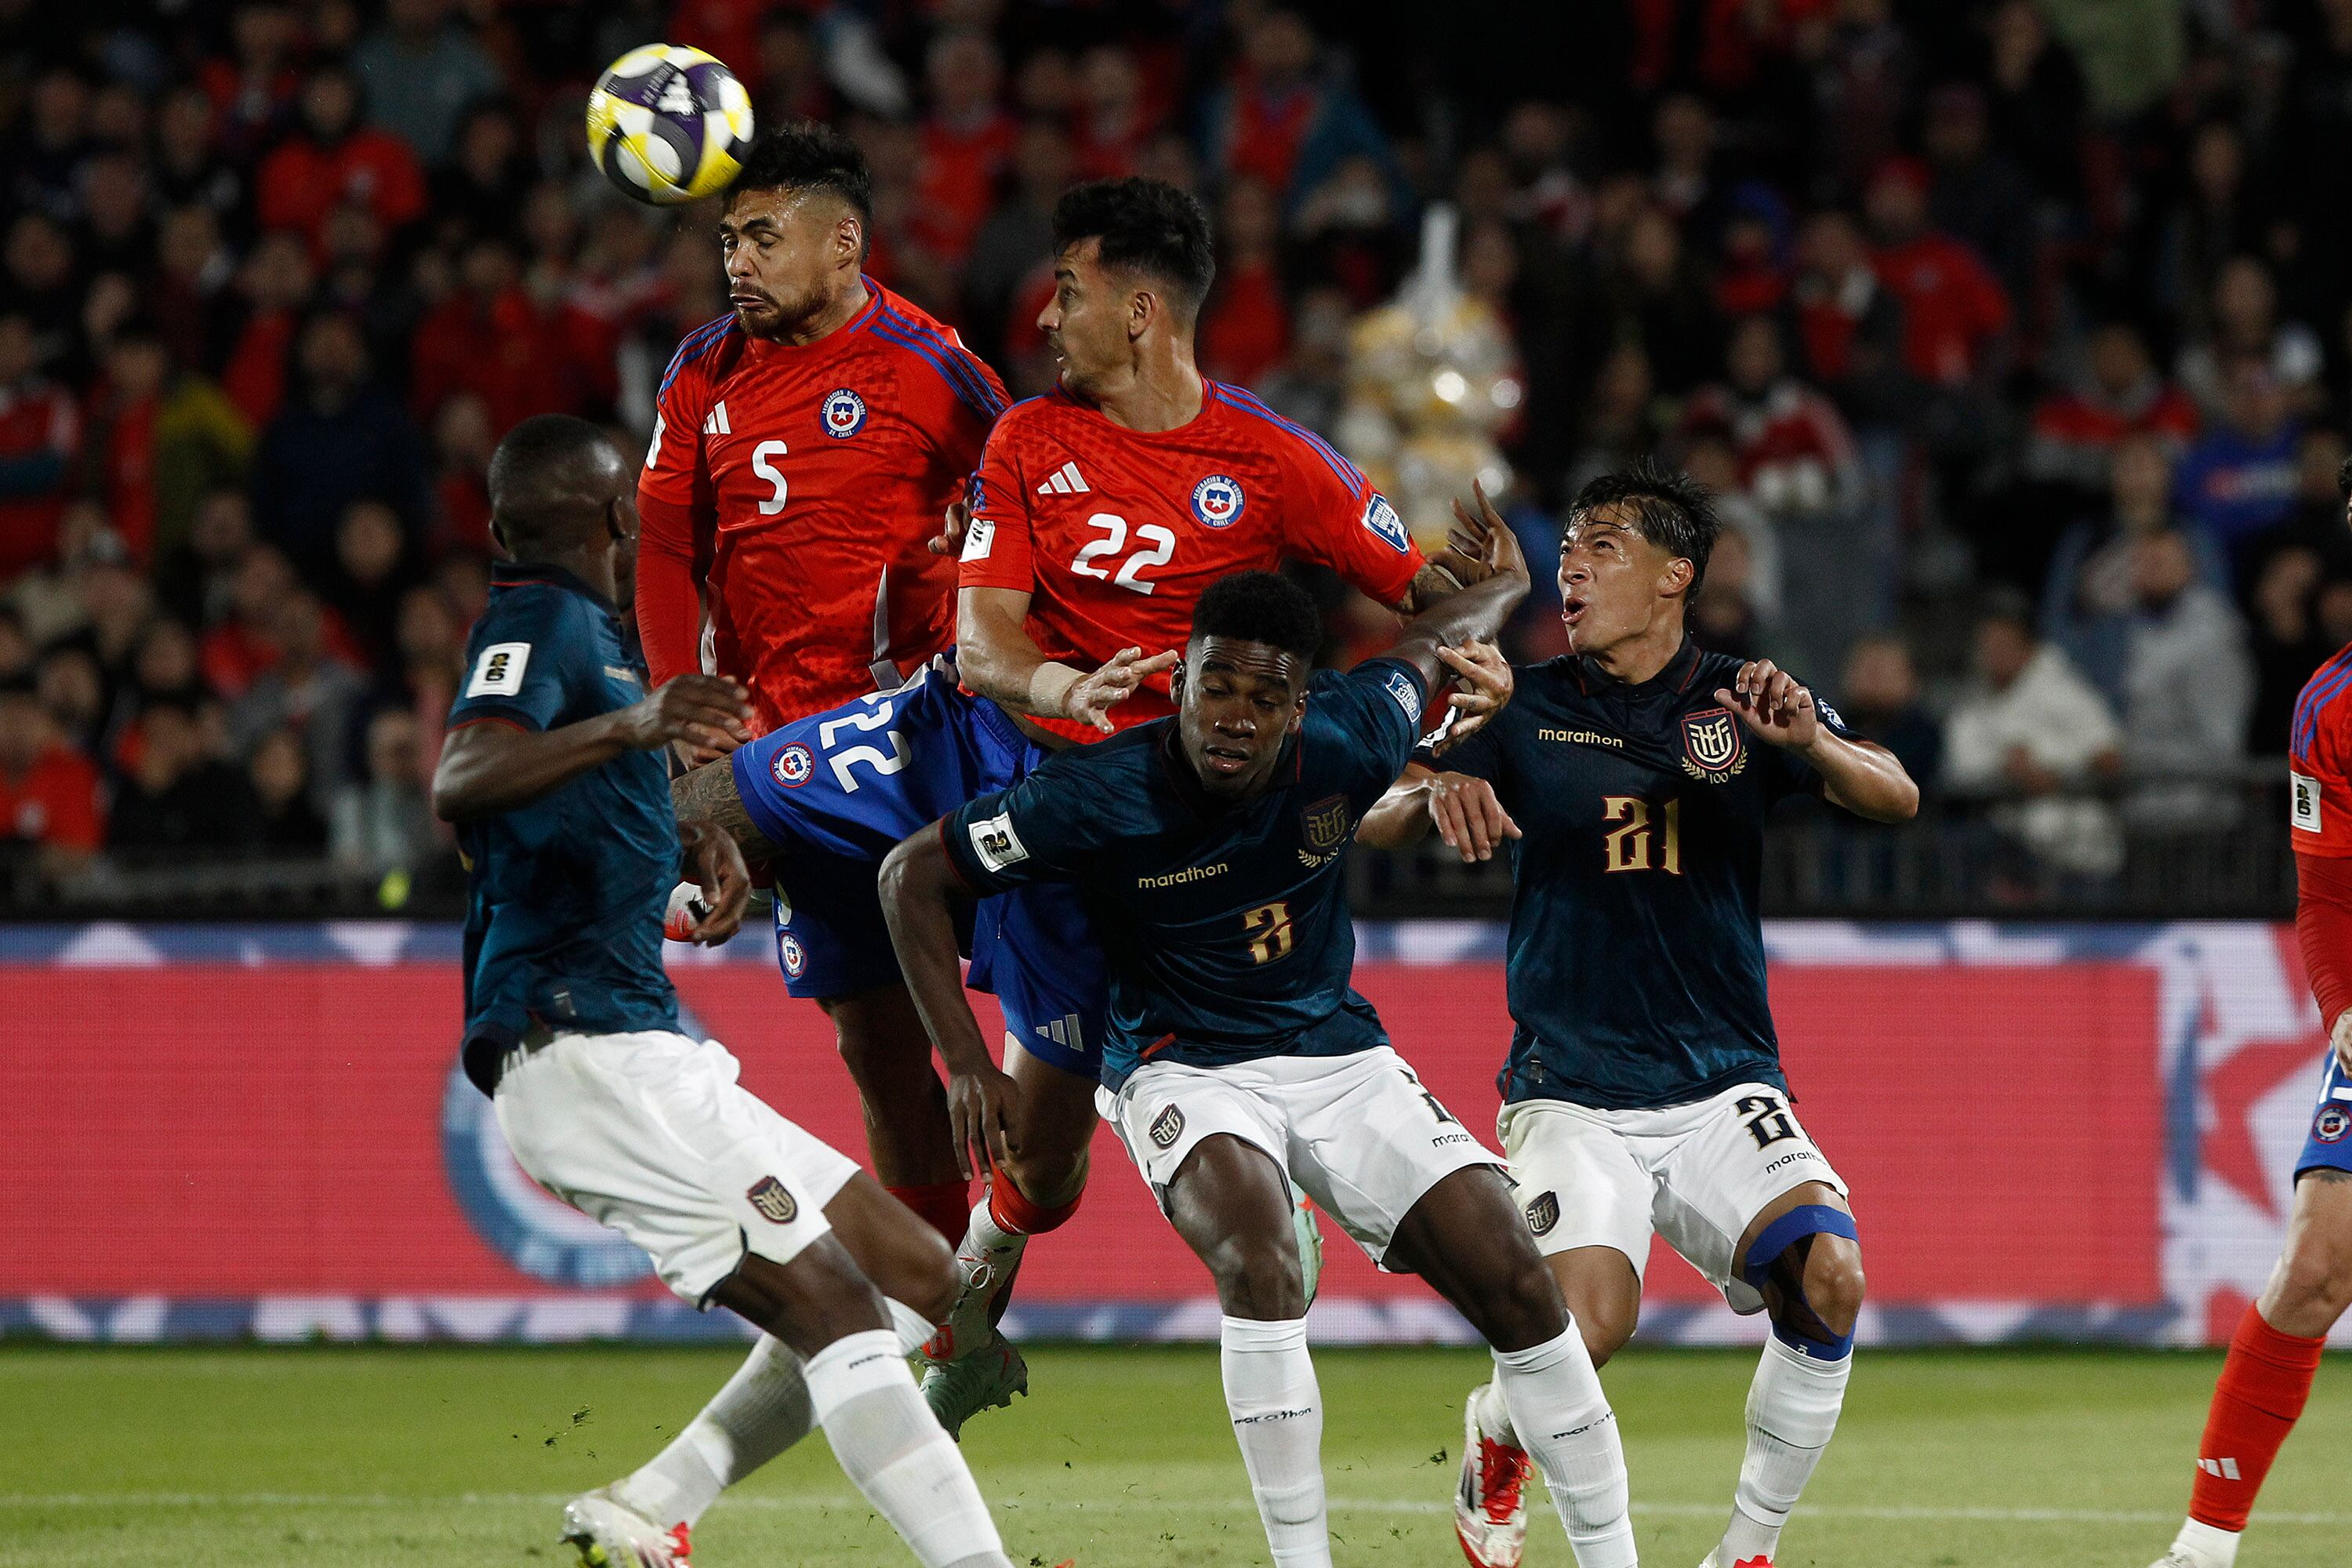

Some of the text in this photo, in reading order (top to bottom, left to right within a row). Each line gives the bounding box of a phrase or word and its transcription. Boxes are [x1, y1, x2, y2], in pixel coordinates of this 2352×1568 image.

[752, 440, 788, 515] 5
[1071, 513, 1176, 595] 22
[819, 700, 911, 793] 22
[1538, 728, 1623, 748] marathon
[1710, 772, 1729, 784] 100
[1601, 795, 1682, 875] 21
[1138, 863, 1229, 888] marathon
[1234, 1407, 1312, 1425] marathon
